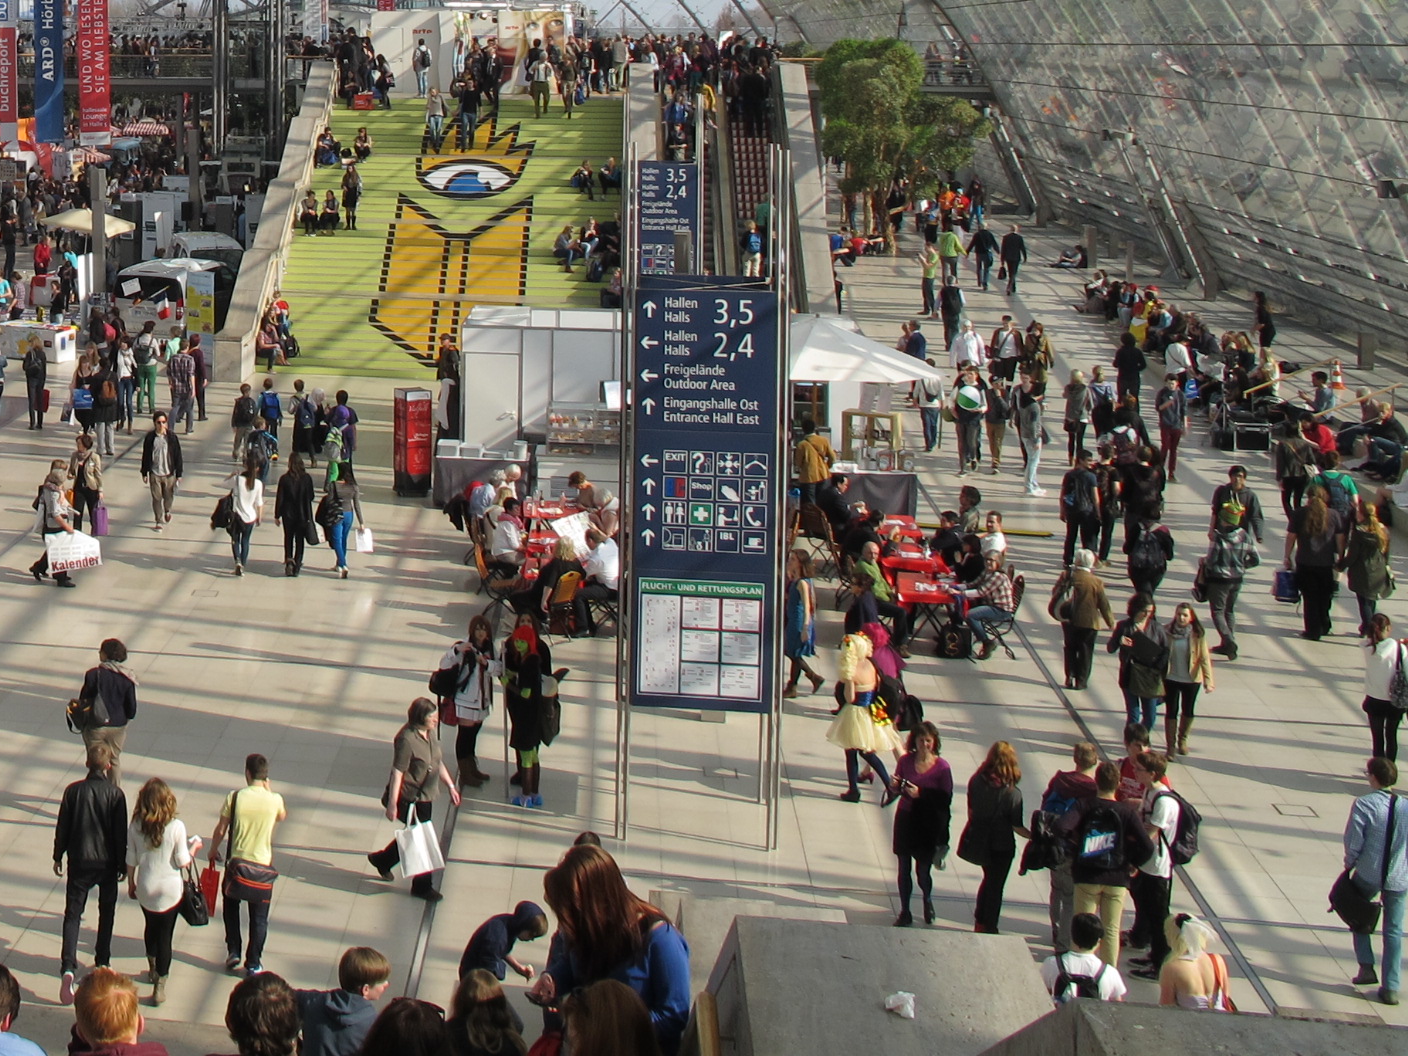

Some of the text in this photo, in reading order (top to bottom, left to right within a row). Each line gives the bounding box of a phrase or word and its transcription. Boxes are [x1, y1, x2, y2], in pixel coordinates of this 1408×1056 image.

[82, 38, 92, 63] WO
[42, 46, 54, 82] ARD
[94, 49, 104, 70] AM
[0, 38, 11, 112] buchreport
[83, 65, 93, 93] UND
[95, 75, 105, 93] SIE
[82, 113, 107, 121] Lounge
[666, 168, 687, 183] 3,5
[666, 185, 687, 200] 2,4
[641, 217, 679, 225] Eingangshalle
[664, 296, 754, 328] Hallen 3,5
[664, 311, 691, 323] Halls
[664, 330, 755, 362] Hallen 2,4
[664, 344, 690, 356] Halls
[663, 363, 726, 378] Freigelände
[663, 378, 736, 391] Outdoor Area
[663, 396, 759, 411] Eingangshalle Ost
[663, 411, 760, 425] Entrance Hall East
[665, 452, 686, 462] EXIT
[691, 482, 712, 491] Shop
[719, 531, 735, 541] IBL
[51, 556, 99, 572] Kalender
[641, 581, 762, 595] FLUCHT- UND RETTUNGSPLAN
[1083, 831, 1117, 853] NIKE
